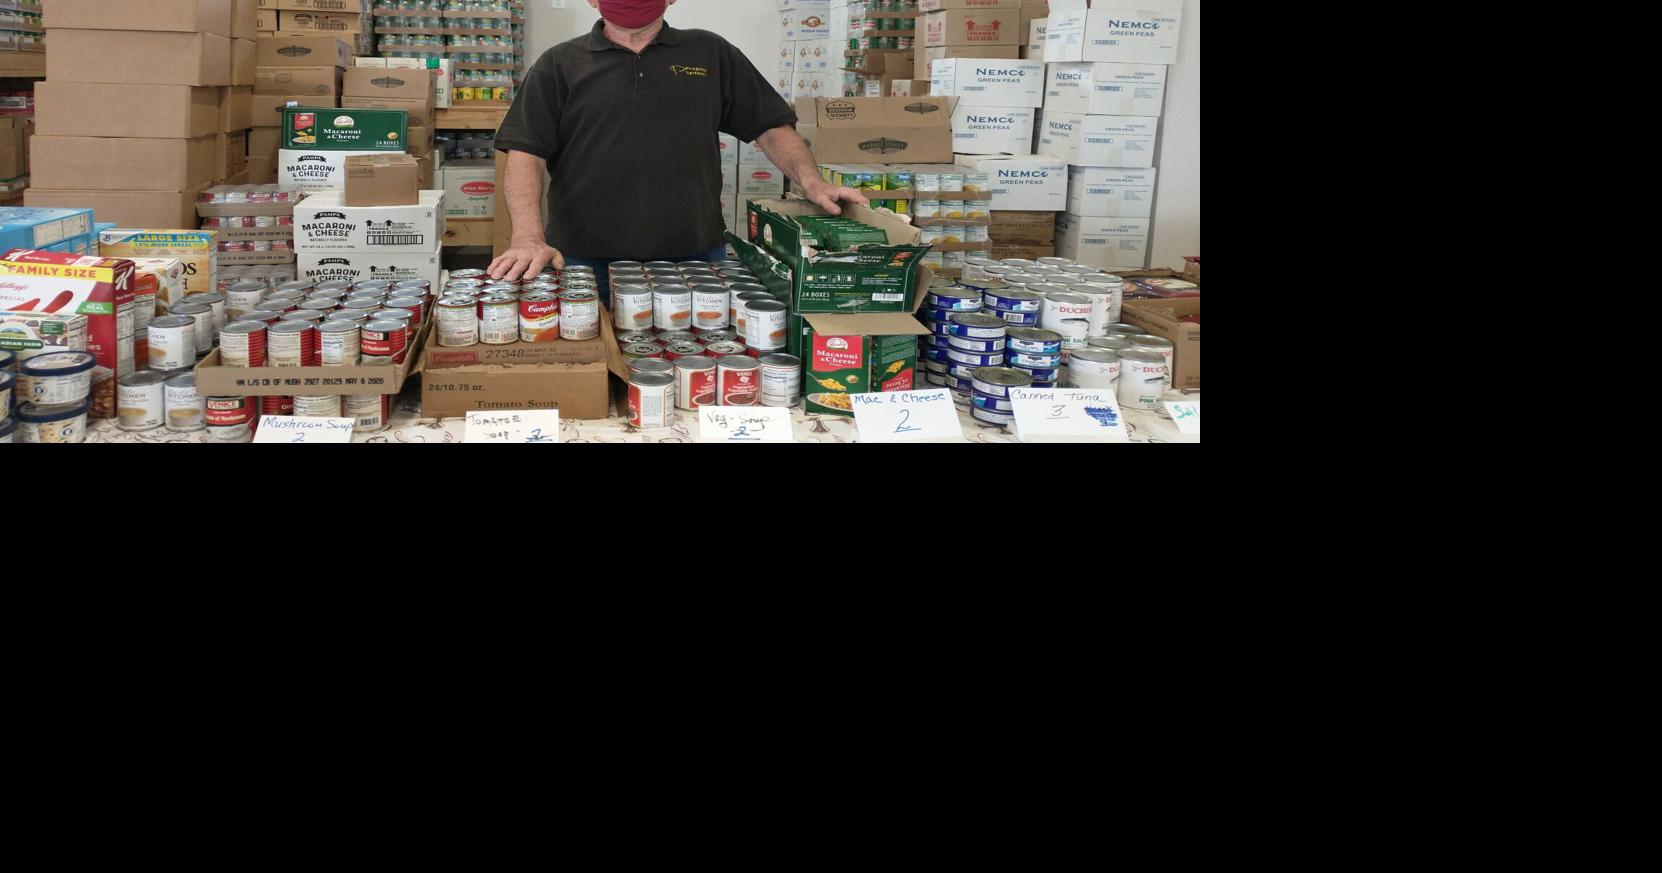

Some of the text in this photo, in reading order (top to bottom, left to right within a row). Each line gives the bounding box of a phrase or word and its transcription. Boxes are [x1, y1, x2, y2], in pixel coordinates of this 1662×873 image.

[286, 164, 336, 172] MACARONI
[301, 222, 356, 231] MACARONI
[315, 229, 350, 237] CHEESE
[7, 264, 97, 278] FAMILY SIZE
[306, 269, 360, 277] MACARONI
[816, 349, 858, 360] Macaroni
[345, 377, 358, 385] MAY
[367, 377, 384, 385] 2020
[427, 383, 470, 392] 24/10.75
[854, 394, 883, 404] Mac
[901, 392, 946, 402] Cheese
[1011, 388, 1055, 400] Canned
[476, 400, 558, 408] Tomato Soup
[1051, 404, 1066, 417] 3
[327, 419, 354, 432] Soup
[893, 409, 922, 433] 2
[292, 432, 305, 442] 2
